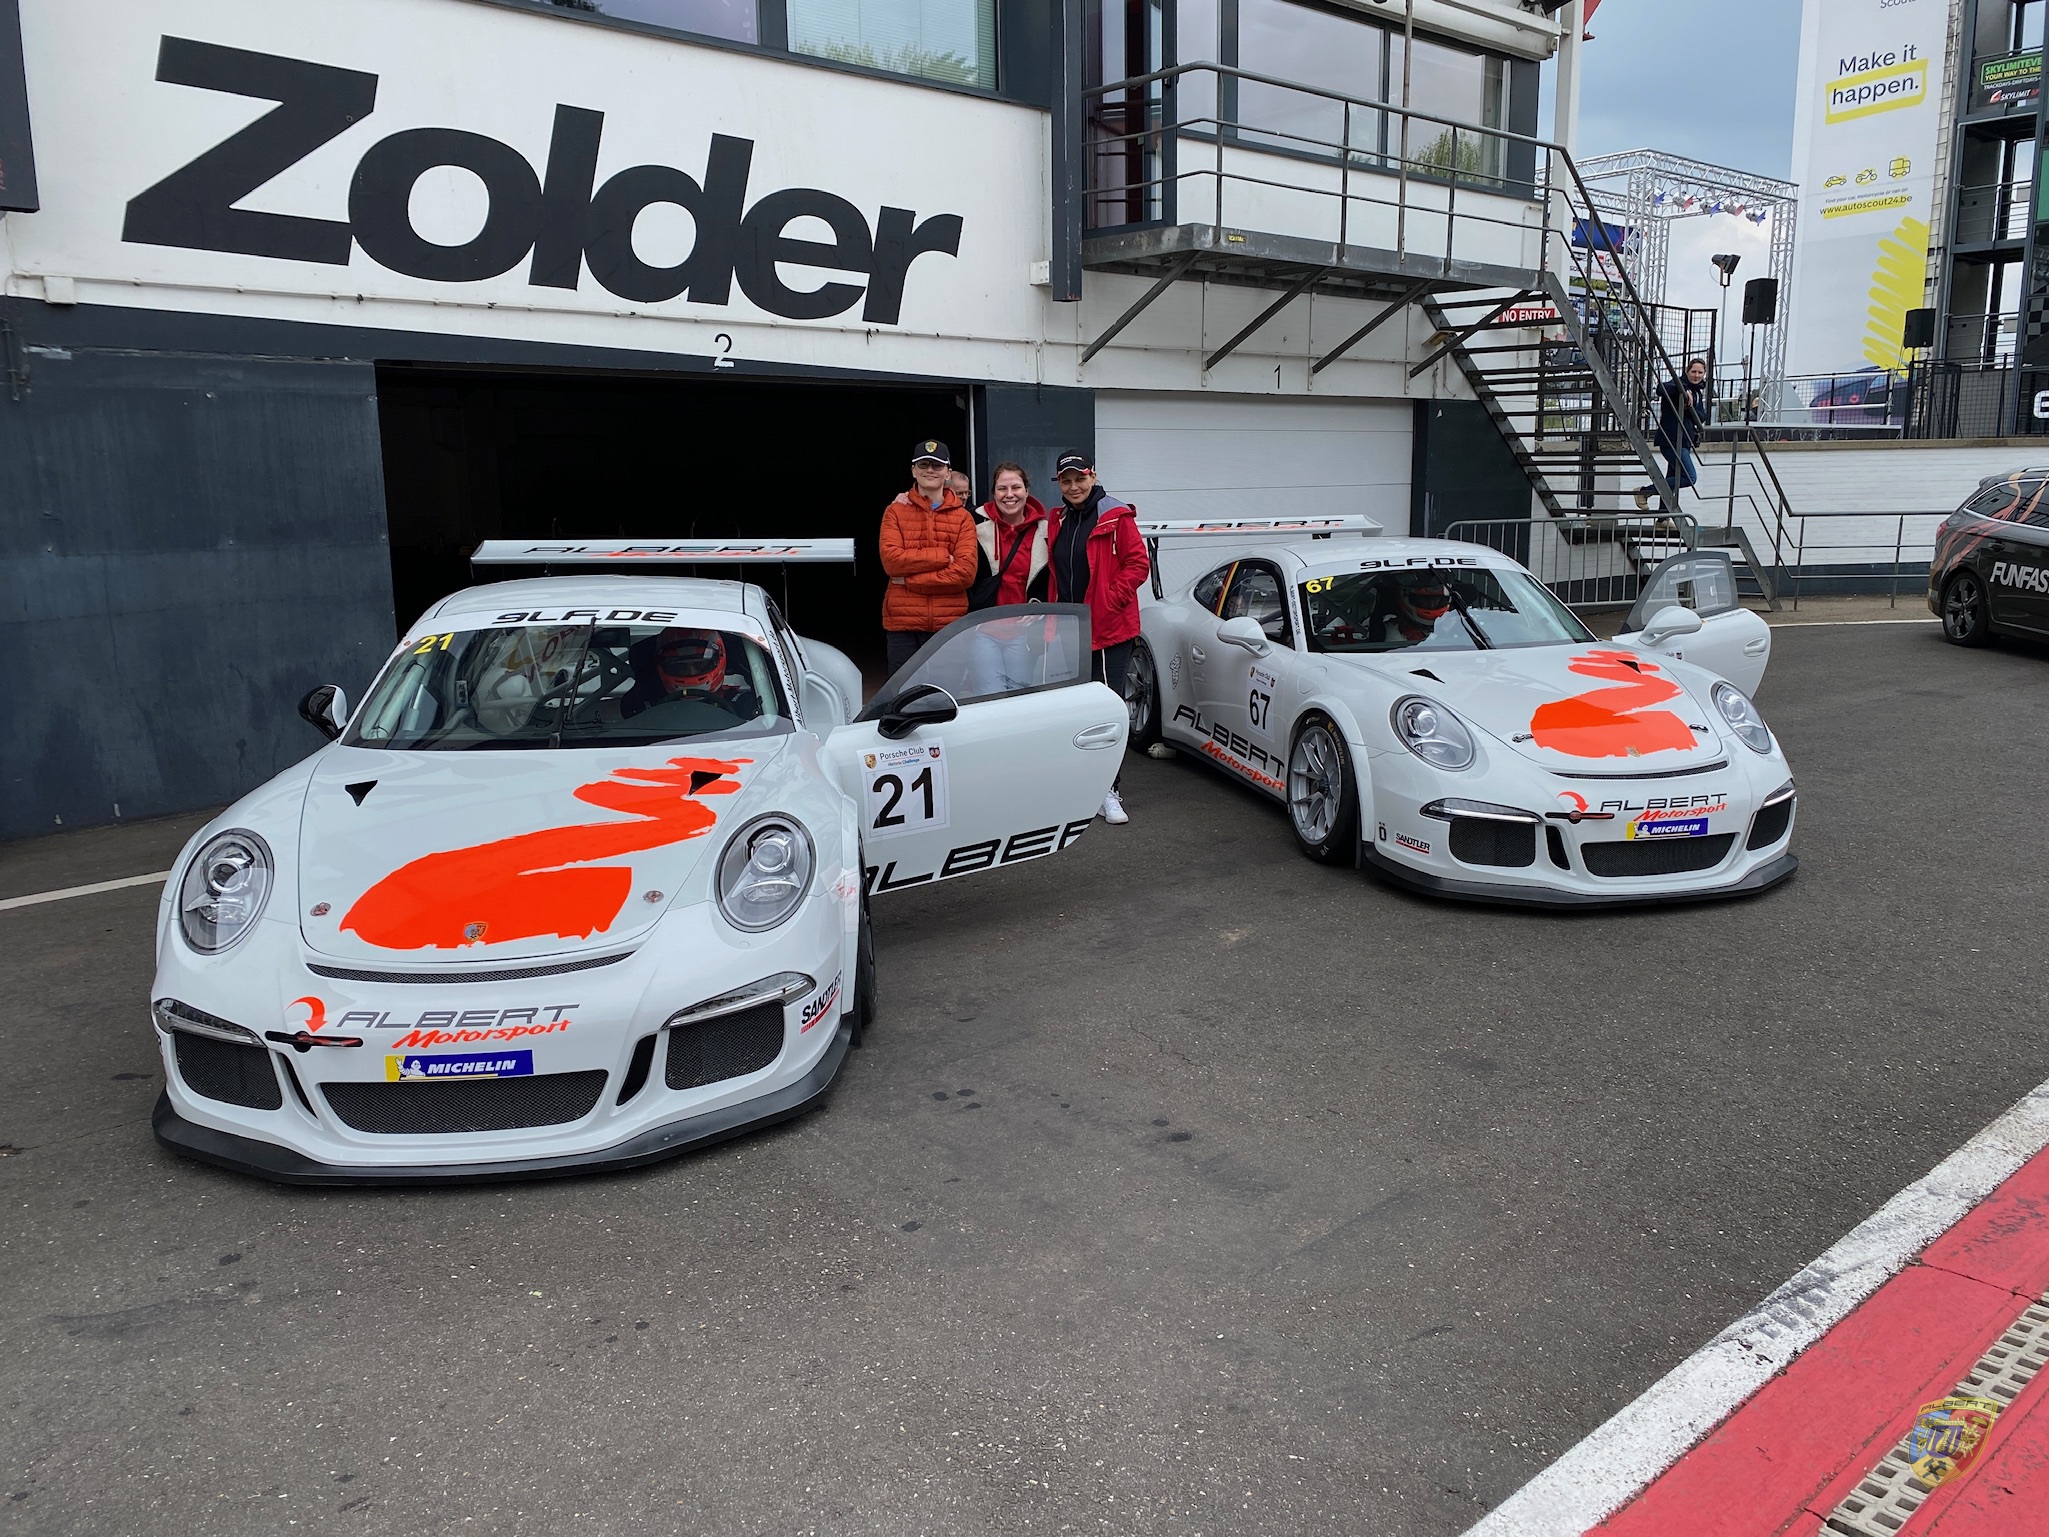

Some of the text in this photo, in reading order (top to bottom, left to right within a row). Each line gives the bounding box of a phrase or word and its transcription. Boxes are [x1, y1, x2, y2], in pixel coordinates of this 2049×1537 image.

[1839, 44, 1917, 76] Make it
[1832, 77, 1919, 105] happen.
[121, 34, 963, 325] Zolder
[1820, 195, 1913, 215] www.autoscout24.be
[1836, 196, 1848, 204] your
[1857, 191, 1885, 200] motorcycle
[1502, 310, 1551, 322] NO ENTRY
[713, 333, 735, 368] 2
[1274, 364, 1281, 389] 1
[1306, 576, 1335, 593] 67
[413, 633, 455, 655] 21
[1249, 688, 1271, 730] 67
[1173, 704, 1285, 778] ALBERT
[880, 747, 925, 760] Porsche Club
[1201, 741, 1286, 792] Motorsport
[872, 767, 934, 829] 21
[1600, 793, 1727, 812] ALBERT
[1633, 802, 1727, 821] Motorsport
[1651, 824, 1700, 834] MICHELIN
[1396, 832, 1431, 850] SANDTLER
[336, 1004, 580, 1028] ALBERT
[391, 1019, 572, 1049] Motorsport
[427, 1059, 516, 1075] MICHELIN
